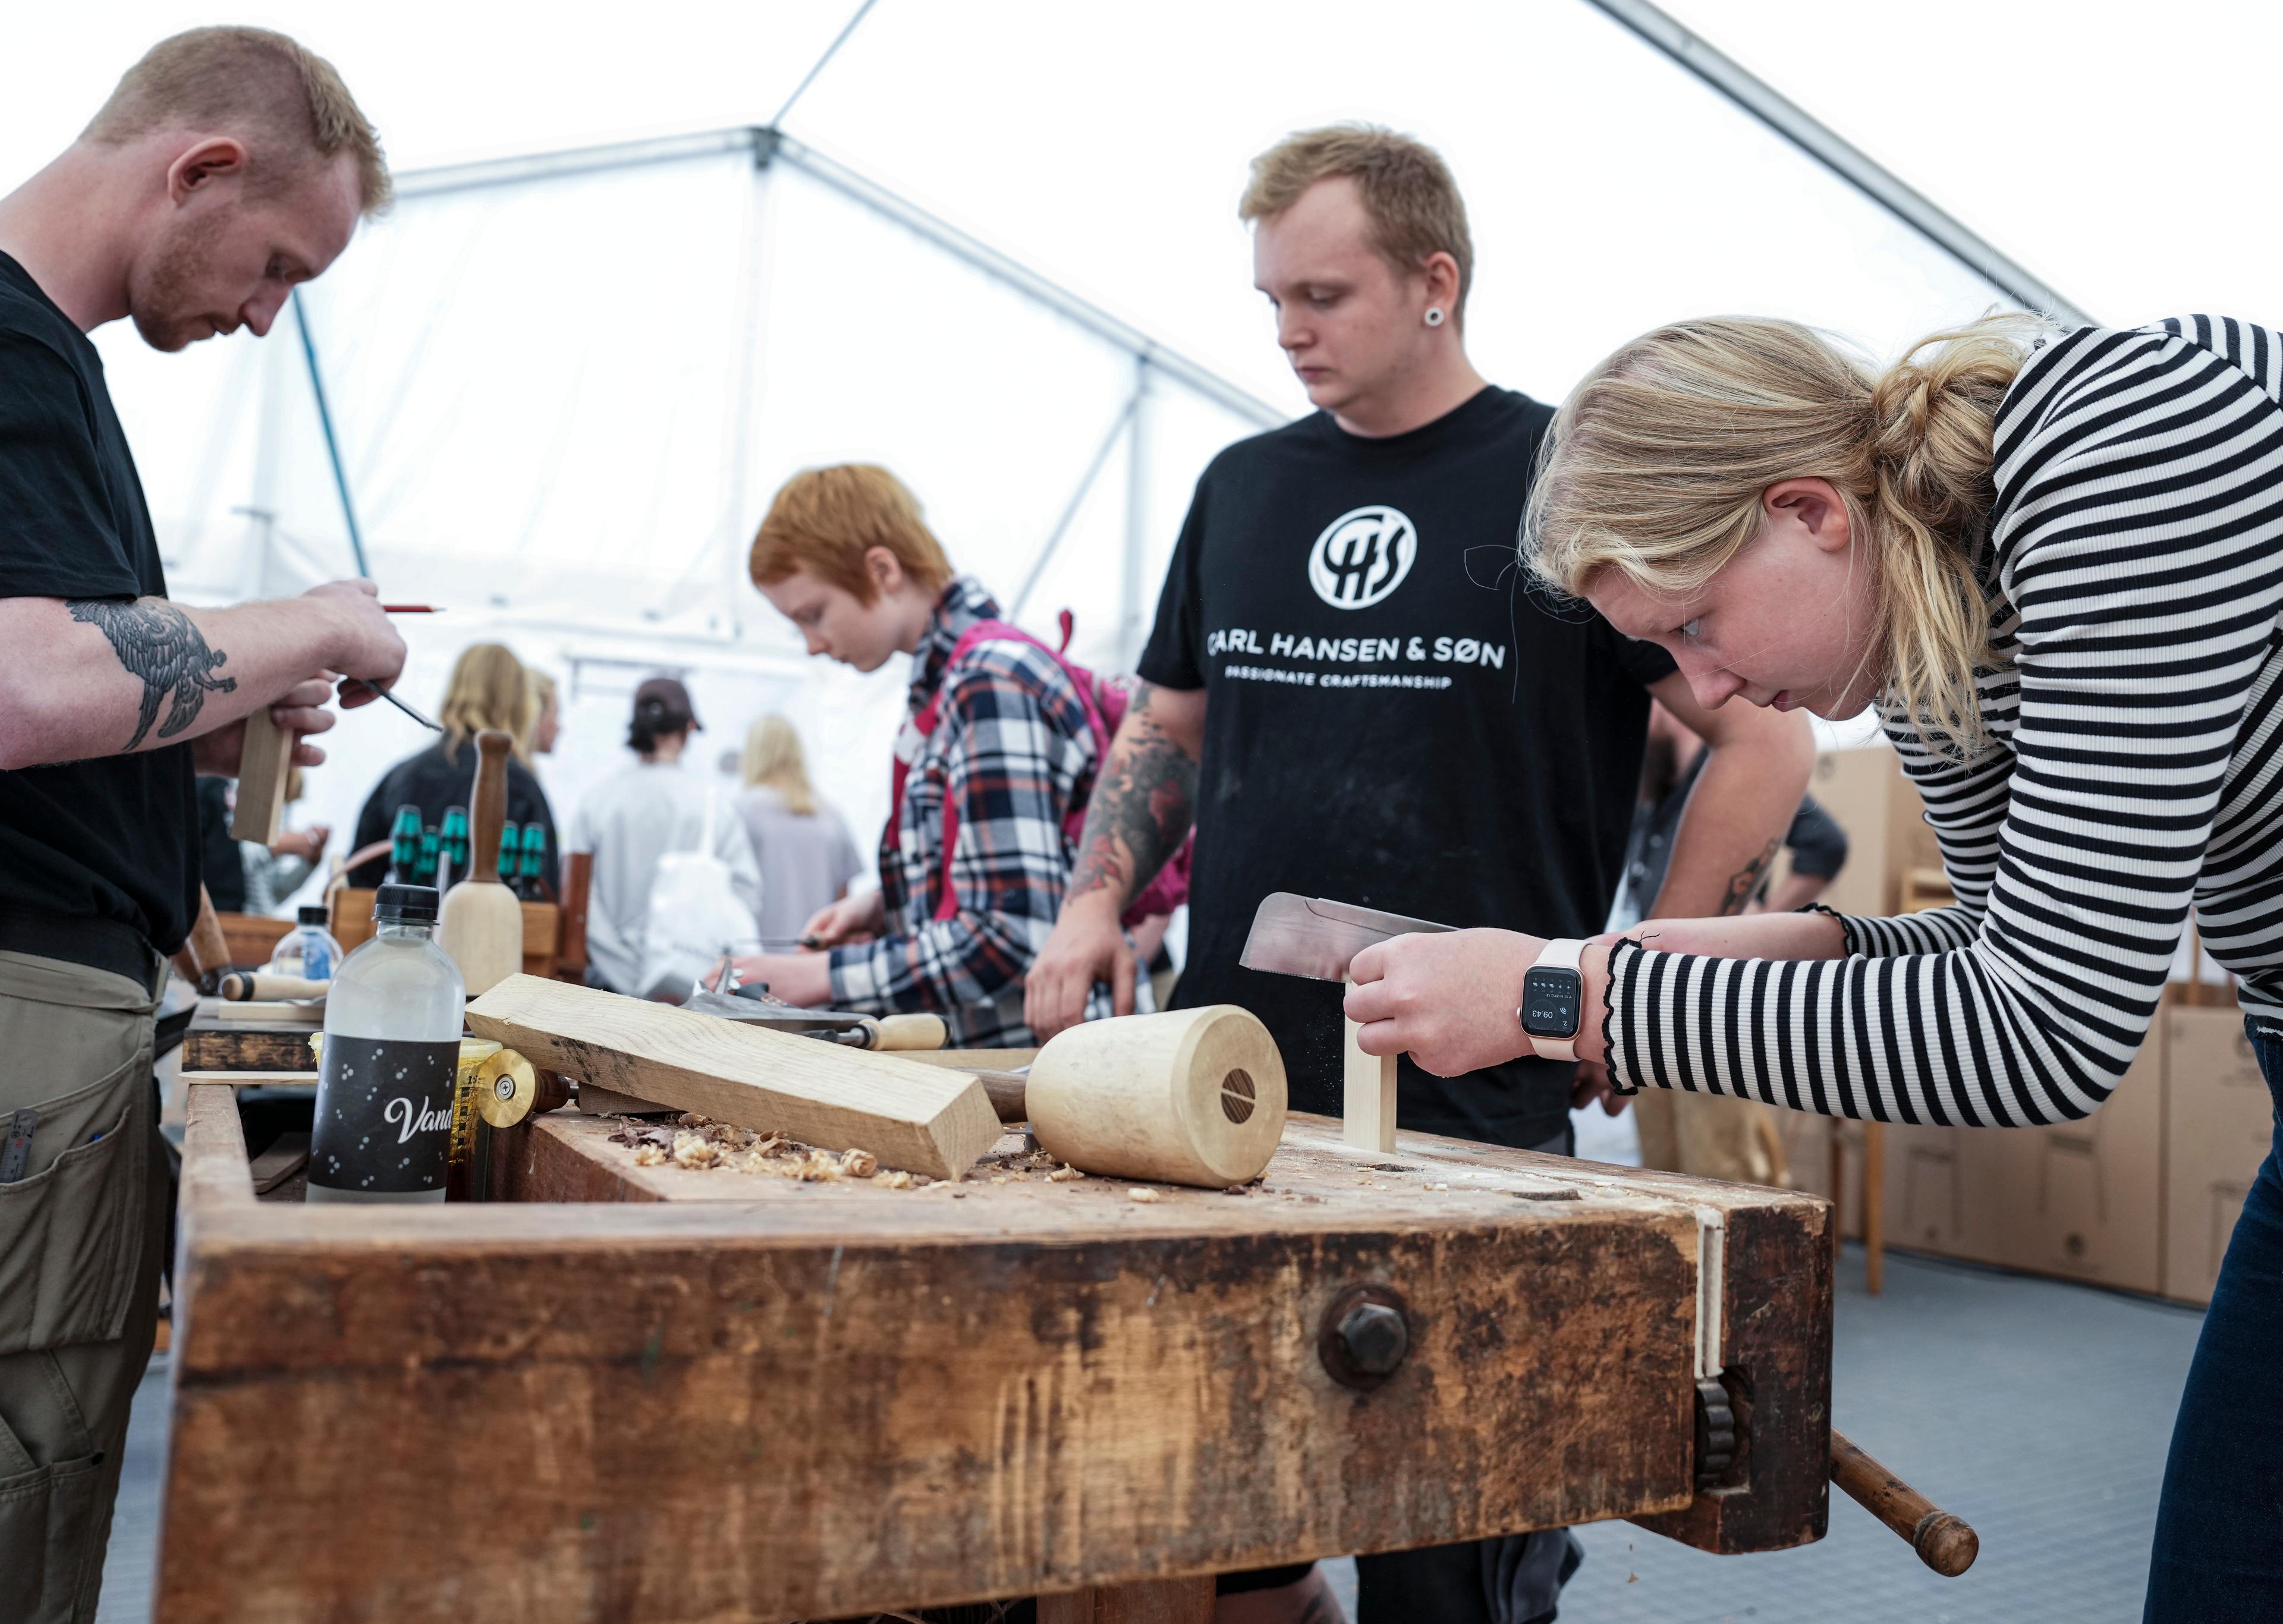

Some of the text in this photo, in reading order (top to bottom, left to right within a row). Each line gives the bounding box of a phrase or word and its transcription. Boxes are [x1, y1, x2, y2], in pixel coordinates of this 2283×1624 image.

[1207, 628, 1506, 670] CARL HANSEN & SØN
[1224, 665, 1452, 690] PASSIONATE CRAFTSMANSHIP
[1532, 1010, 1553, 1019] 09.43
